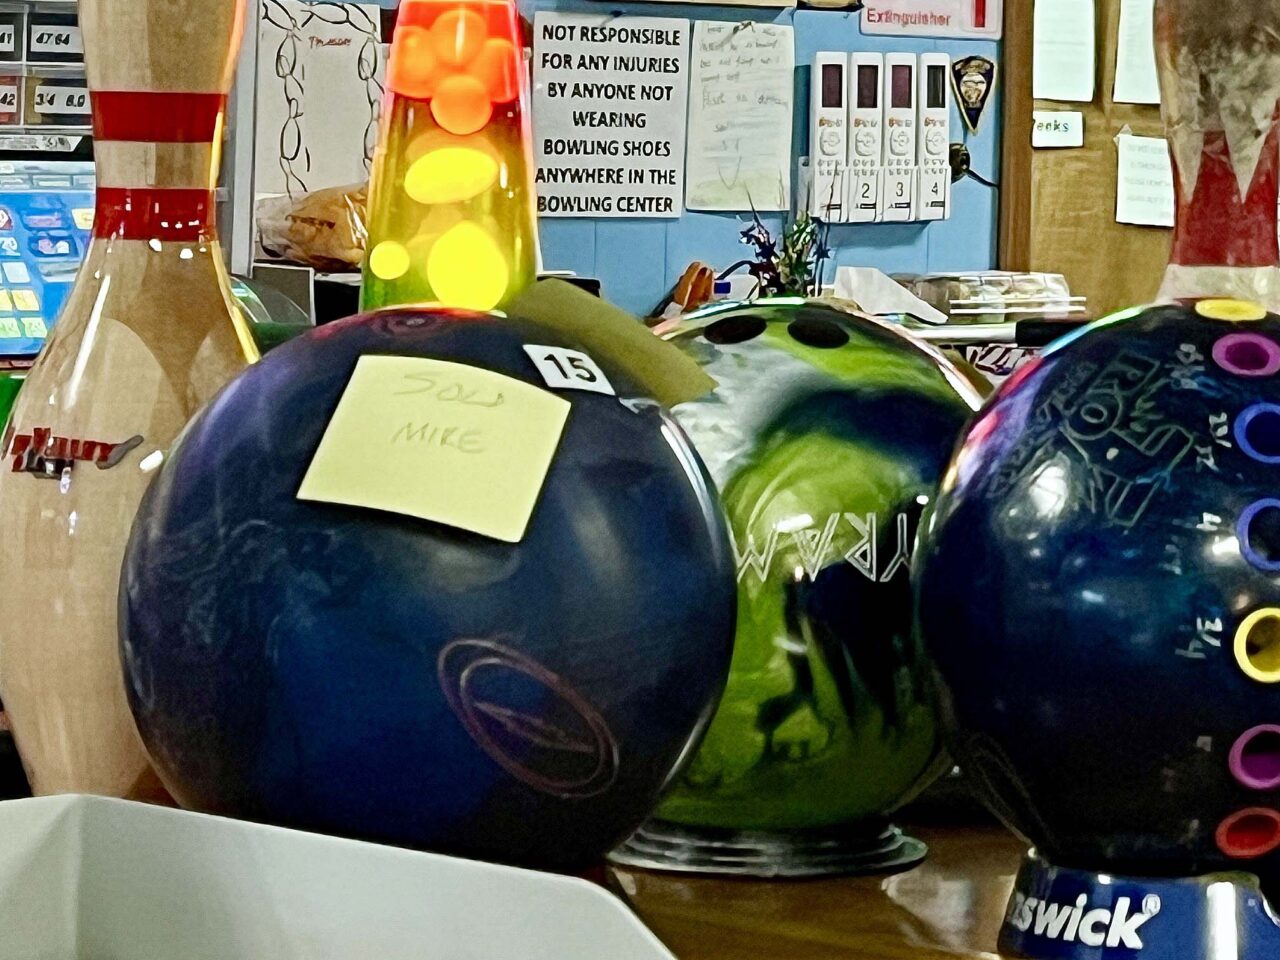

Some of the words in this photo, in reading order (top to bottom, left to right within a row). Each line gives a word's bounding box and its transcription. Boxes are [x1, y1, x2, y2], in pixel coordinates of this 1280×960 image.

[867, 7, 952, 27] Extinguisher
[543, 25, 576, 40] NOT
[580, 26, 680, 46] RESPONSIBLE
[542, 53, 572, 70] FOR
[577, 55, 610, 71] ANY
[614, 56, 680, 74] INJURIES
[548, 82, 566, 98] BY
[572, 83, 636, 100] ANYONE
[640, 86, 673, 101] NOT
[573, 110, 647, 128] WEARING
[544, 139, 618, 156] BOWLING
[623, 140, 670, 157] SHOES
[535, 168, 624, 184] ANYWHERE
[629, 168, 644, 184] IN
[650, 169, 676, 185] THE
[861, 182, 871, 198] 2
[895, 181, 904, 197] 3
[537, 196, 612, 212] BOWLING
[617, 196, 673, 212] CENTER
[543, 353, 597, 384] 15
[391, 421, 487, 454] MIKE
